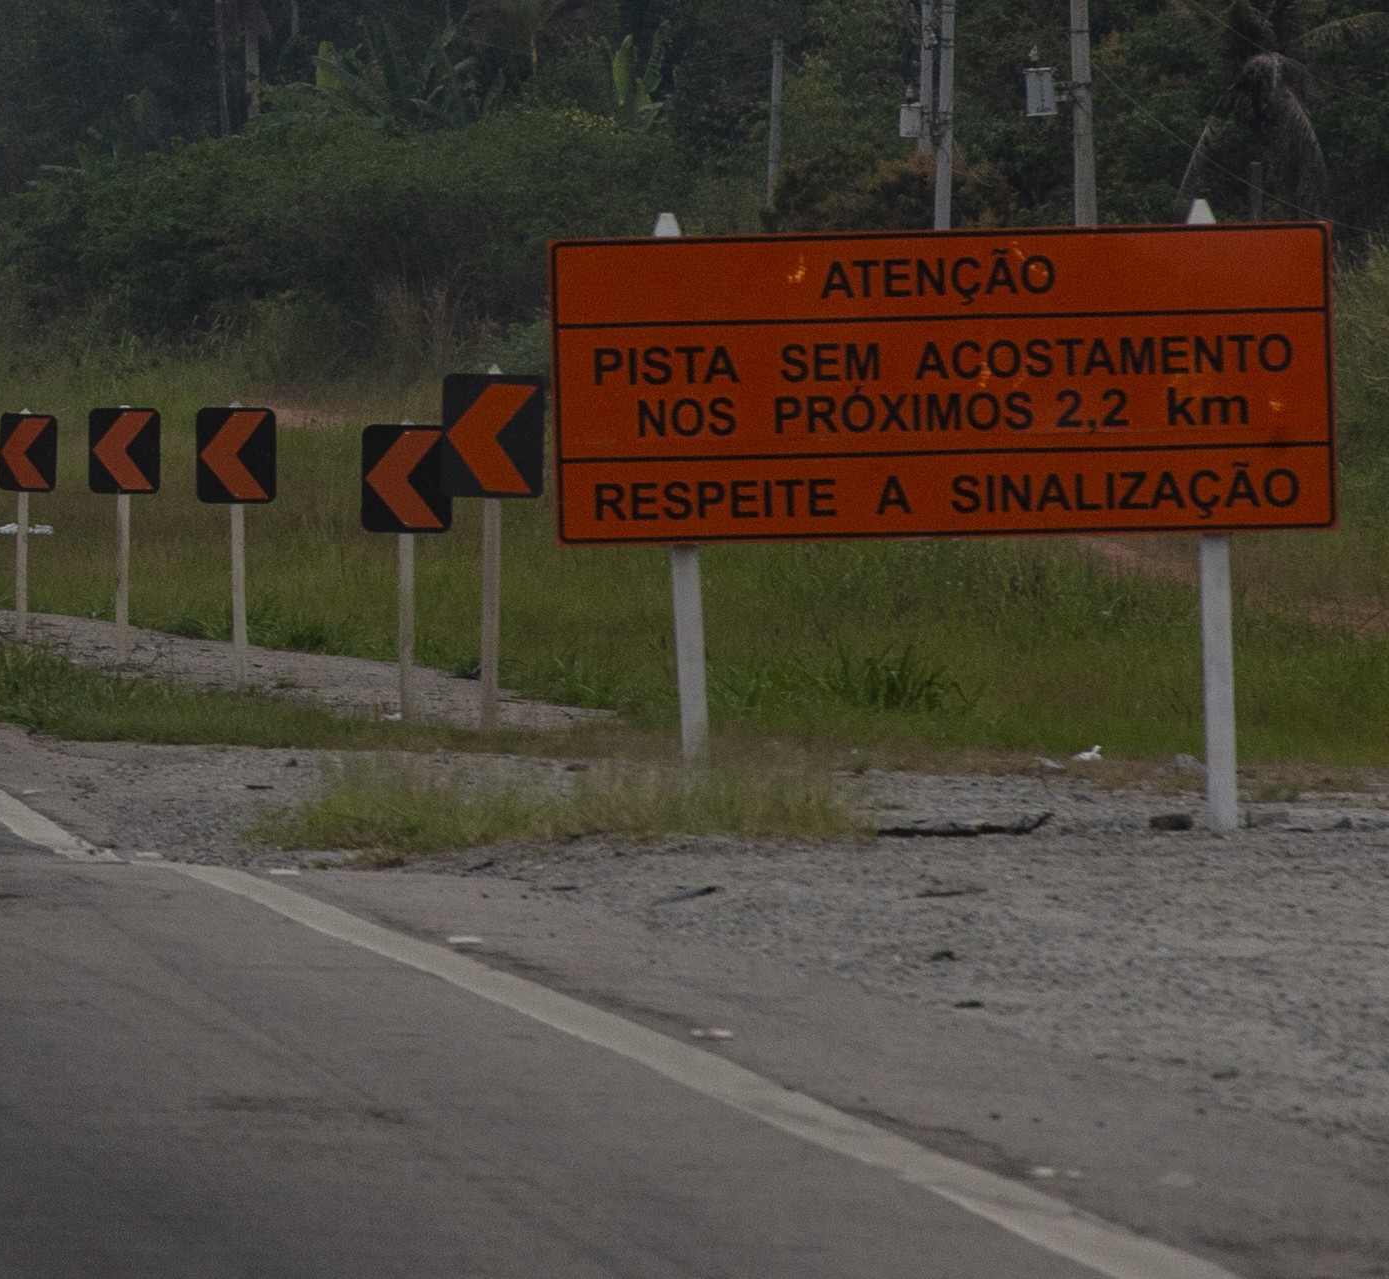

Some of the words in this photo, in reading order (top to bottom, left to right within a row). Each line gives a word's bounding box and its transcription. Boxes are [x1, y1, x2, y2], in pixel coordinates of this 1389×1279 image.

[821, 248, 1057, 305] ATENÇÃO
[592, 346, 739, 387] PISTA
[780, 341, 881, 383] SEM
[916, 333, 1294, 383] ACOSTAMENTO
[638, 396, 738, 438] NOS
[774, 386, 1033, 436] PRÓXIMOS
[1055, 389, 1129, 436] 2,2
[1166, 386, 1250, 428] km
[593, 478, 838, 522] RESPEITE
[877, 475, 912, 515] A
[951, 462, 1301, 519] SINALIZAÇÃO
